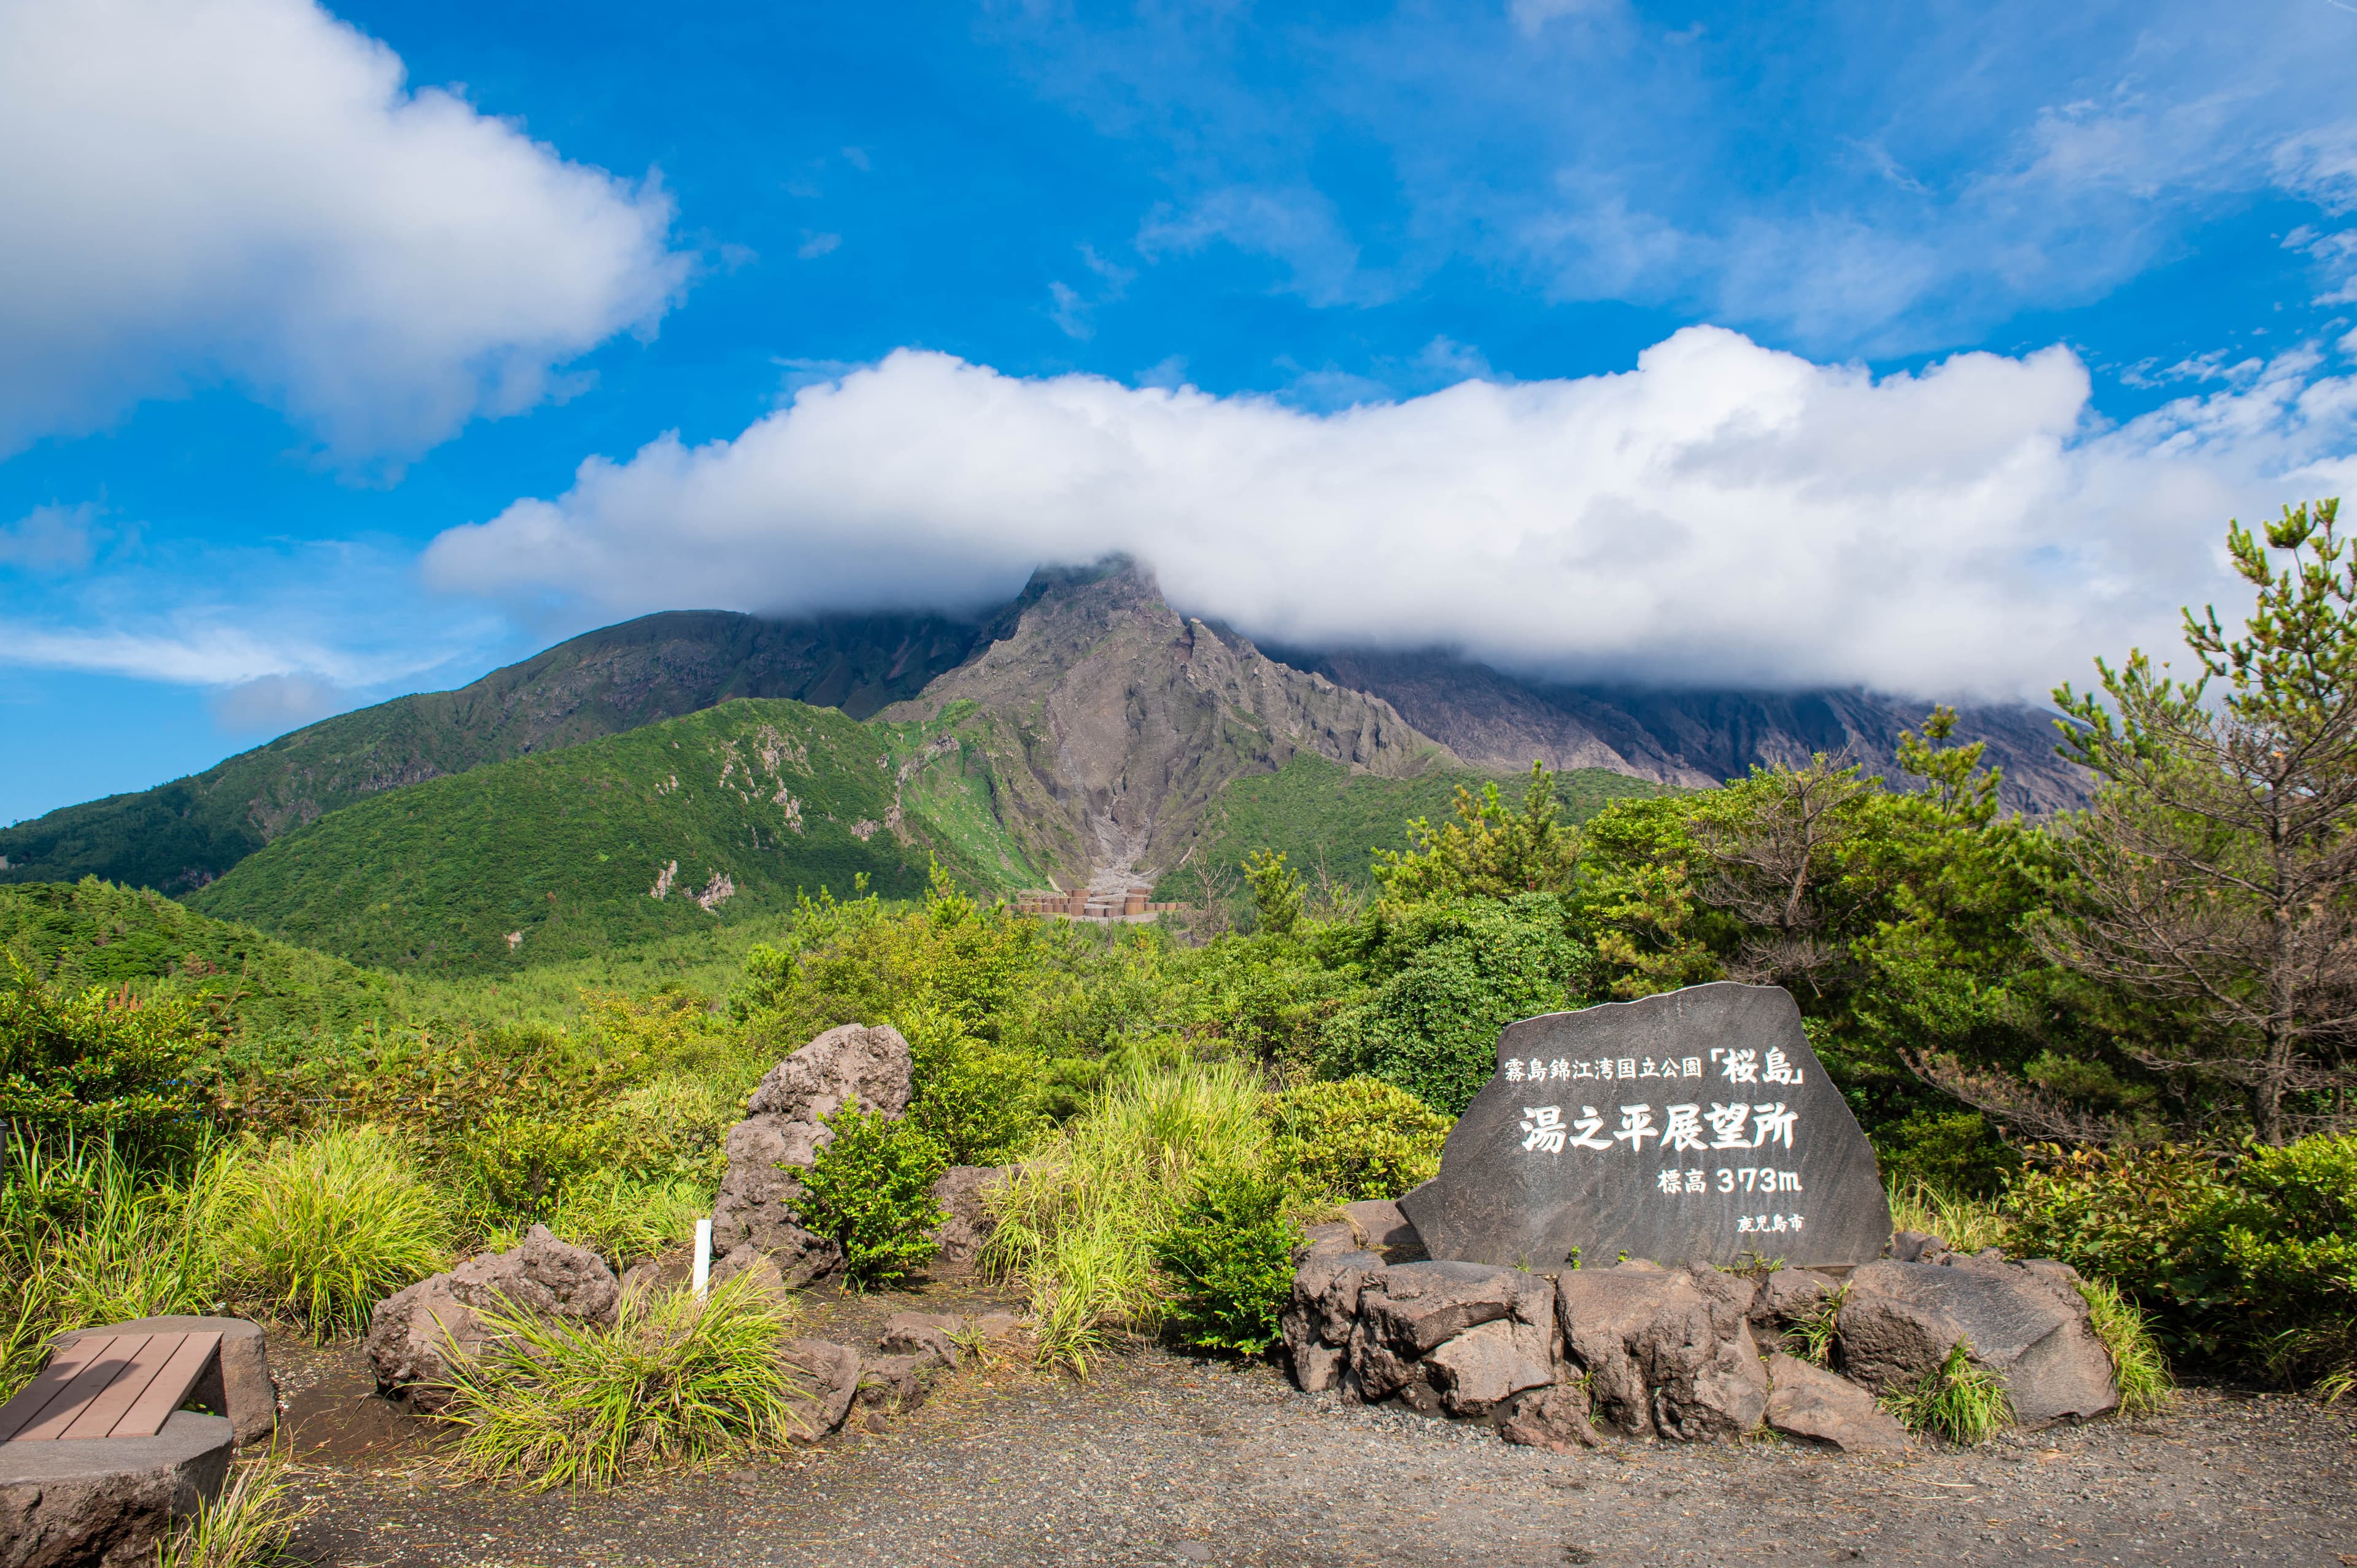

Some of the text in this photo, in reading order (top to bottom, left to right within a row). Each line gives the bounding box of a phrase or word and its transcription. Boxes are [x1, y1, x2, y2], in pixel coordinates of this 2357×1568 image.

[1505, 1046, 1803, 1085] 霧島錦江湾国立公園 「桜島」
[1520, 1102, 1799, 1153] 湯之平展望所
[1657, 1167, 1802, 1194] 標高 373m
[1737, 1213, 1805, 1232] 鹿児島市
